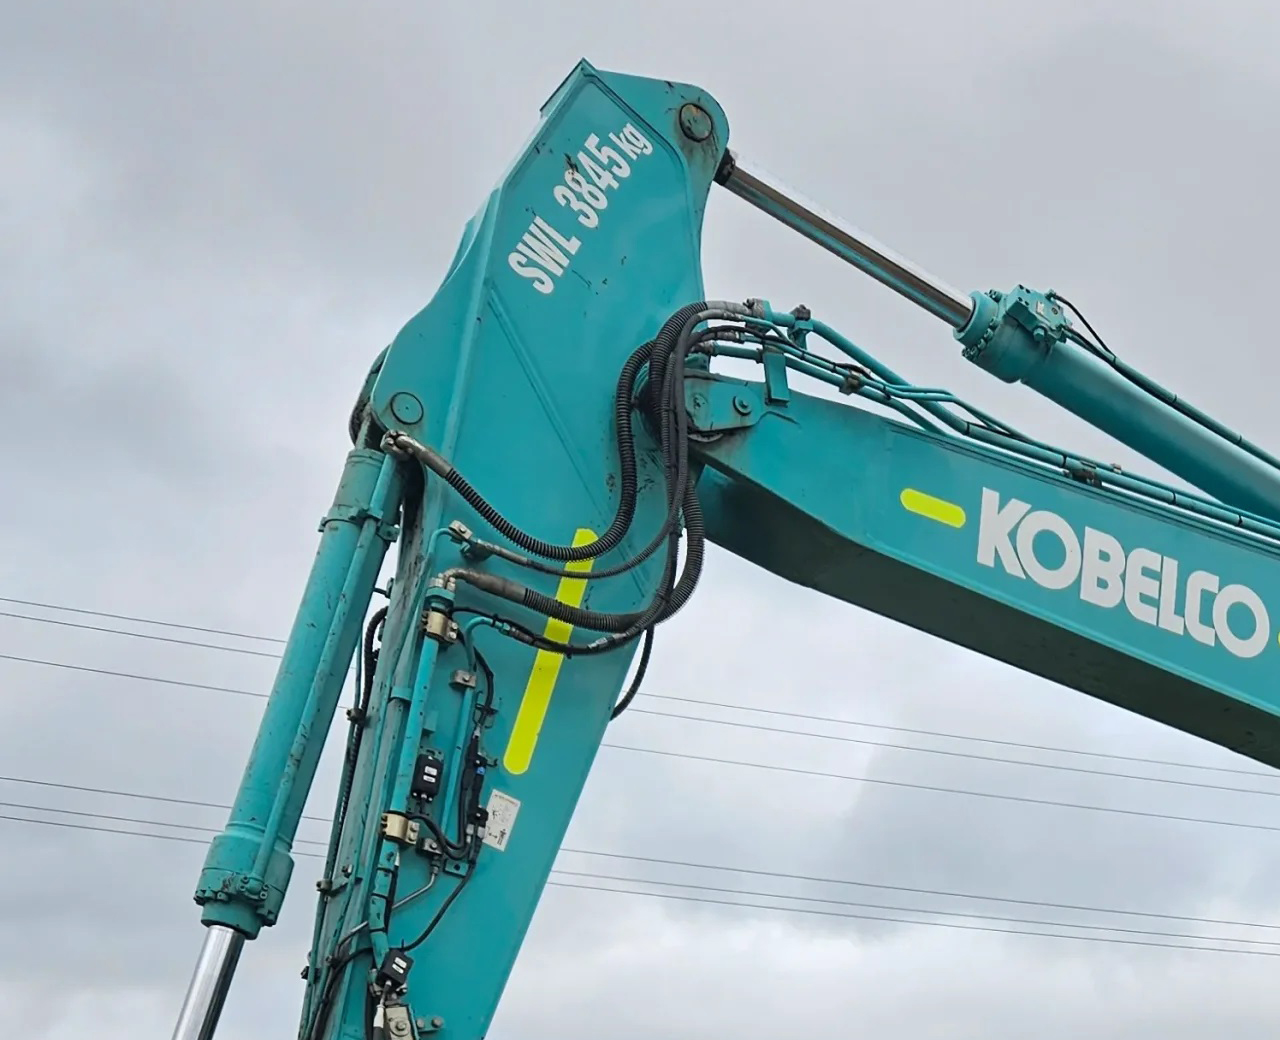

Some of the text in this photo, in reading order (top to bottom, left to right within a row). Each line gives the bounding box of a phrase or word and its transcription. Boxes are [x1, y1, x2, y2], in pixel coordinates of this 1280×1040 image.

[507, 122, 653, 294] SWL 3845 kg
[976, 486, 1270, 658] KOBELCO
